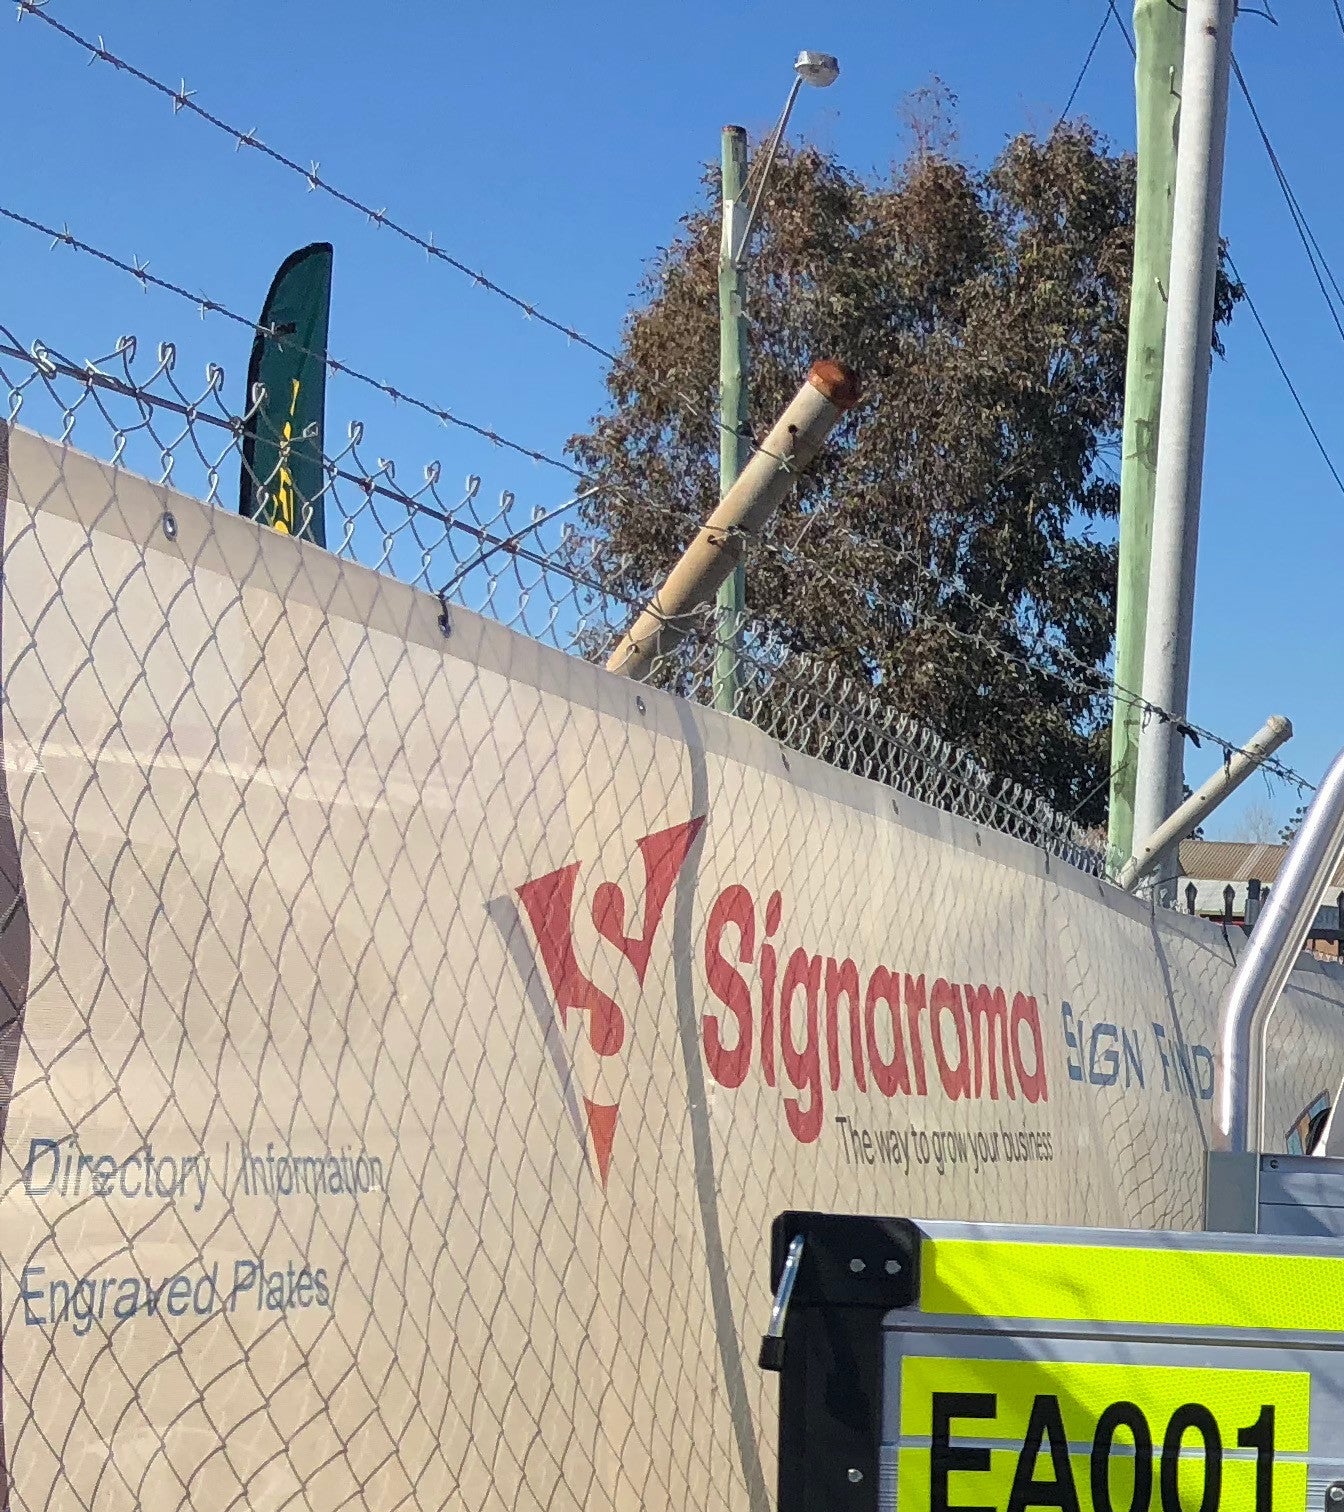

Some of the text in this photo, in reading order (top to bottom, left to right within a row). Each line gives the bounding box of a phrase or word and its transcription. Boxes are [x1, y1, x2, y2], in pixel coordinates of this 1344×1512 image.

[702, 884, 1049, 1144] Signarama
[1061, 1000, 1146, 1090] SIGN
[24, 1134, 210, 1212] Directory
[242, 1142, 385, 1197] Information
[835, 1116, 1054, 1176] The way to grow your business
[20, 1259, 330, 1336] Engraved Plates
